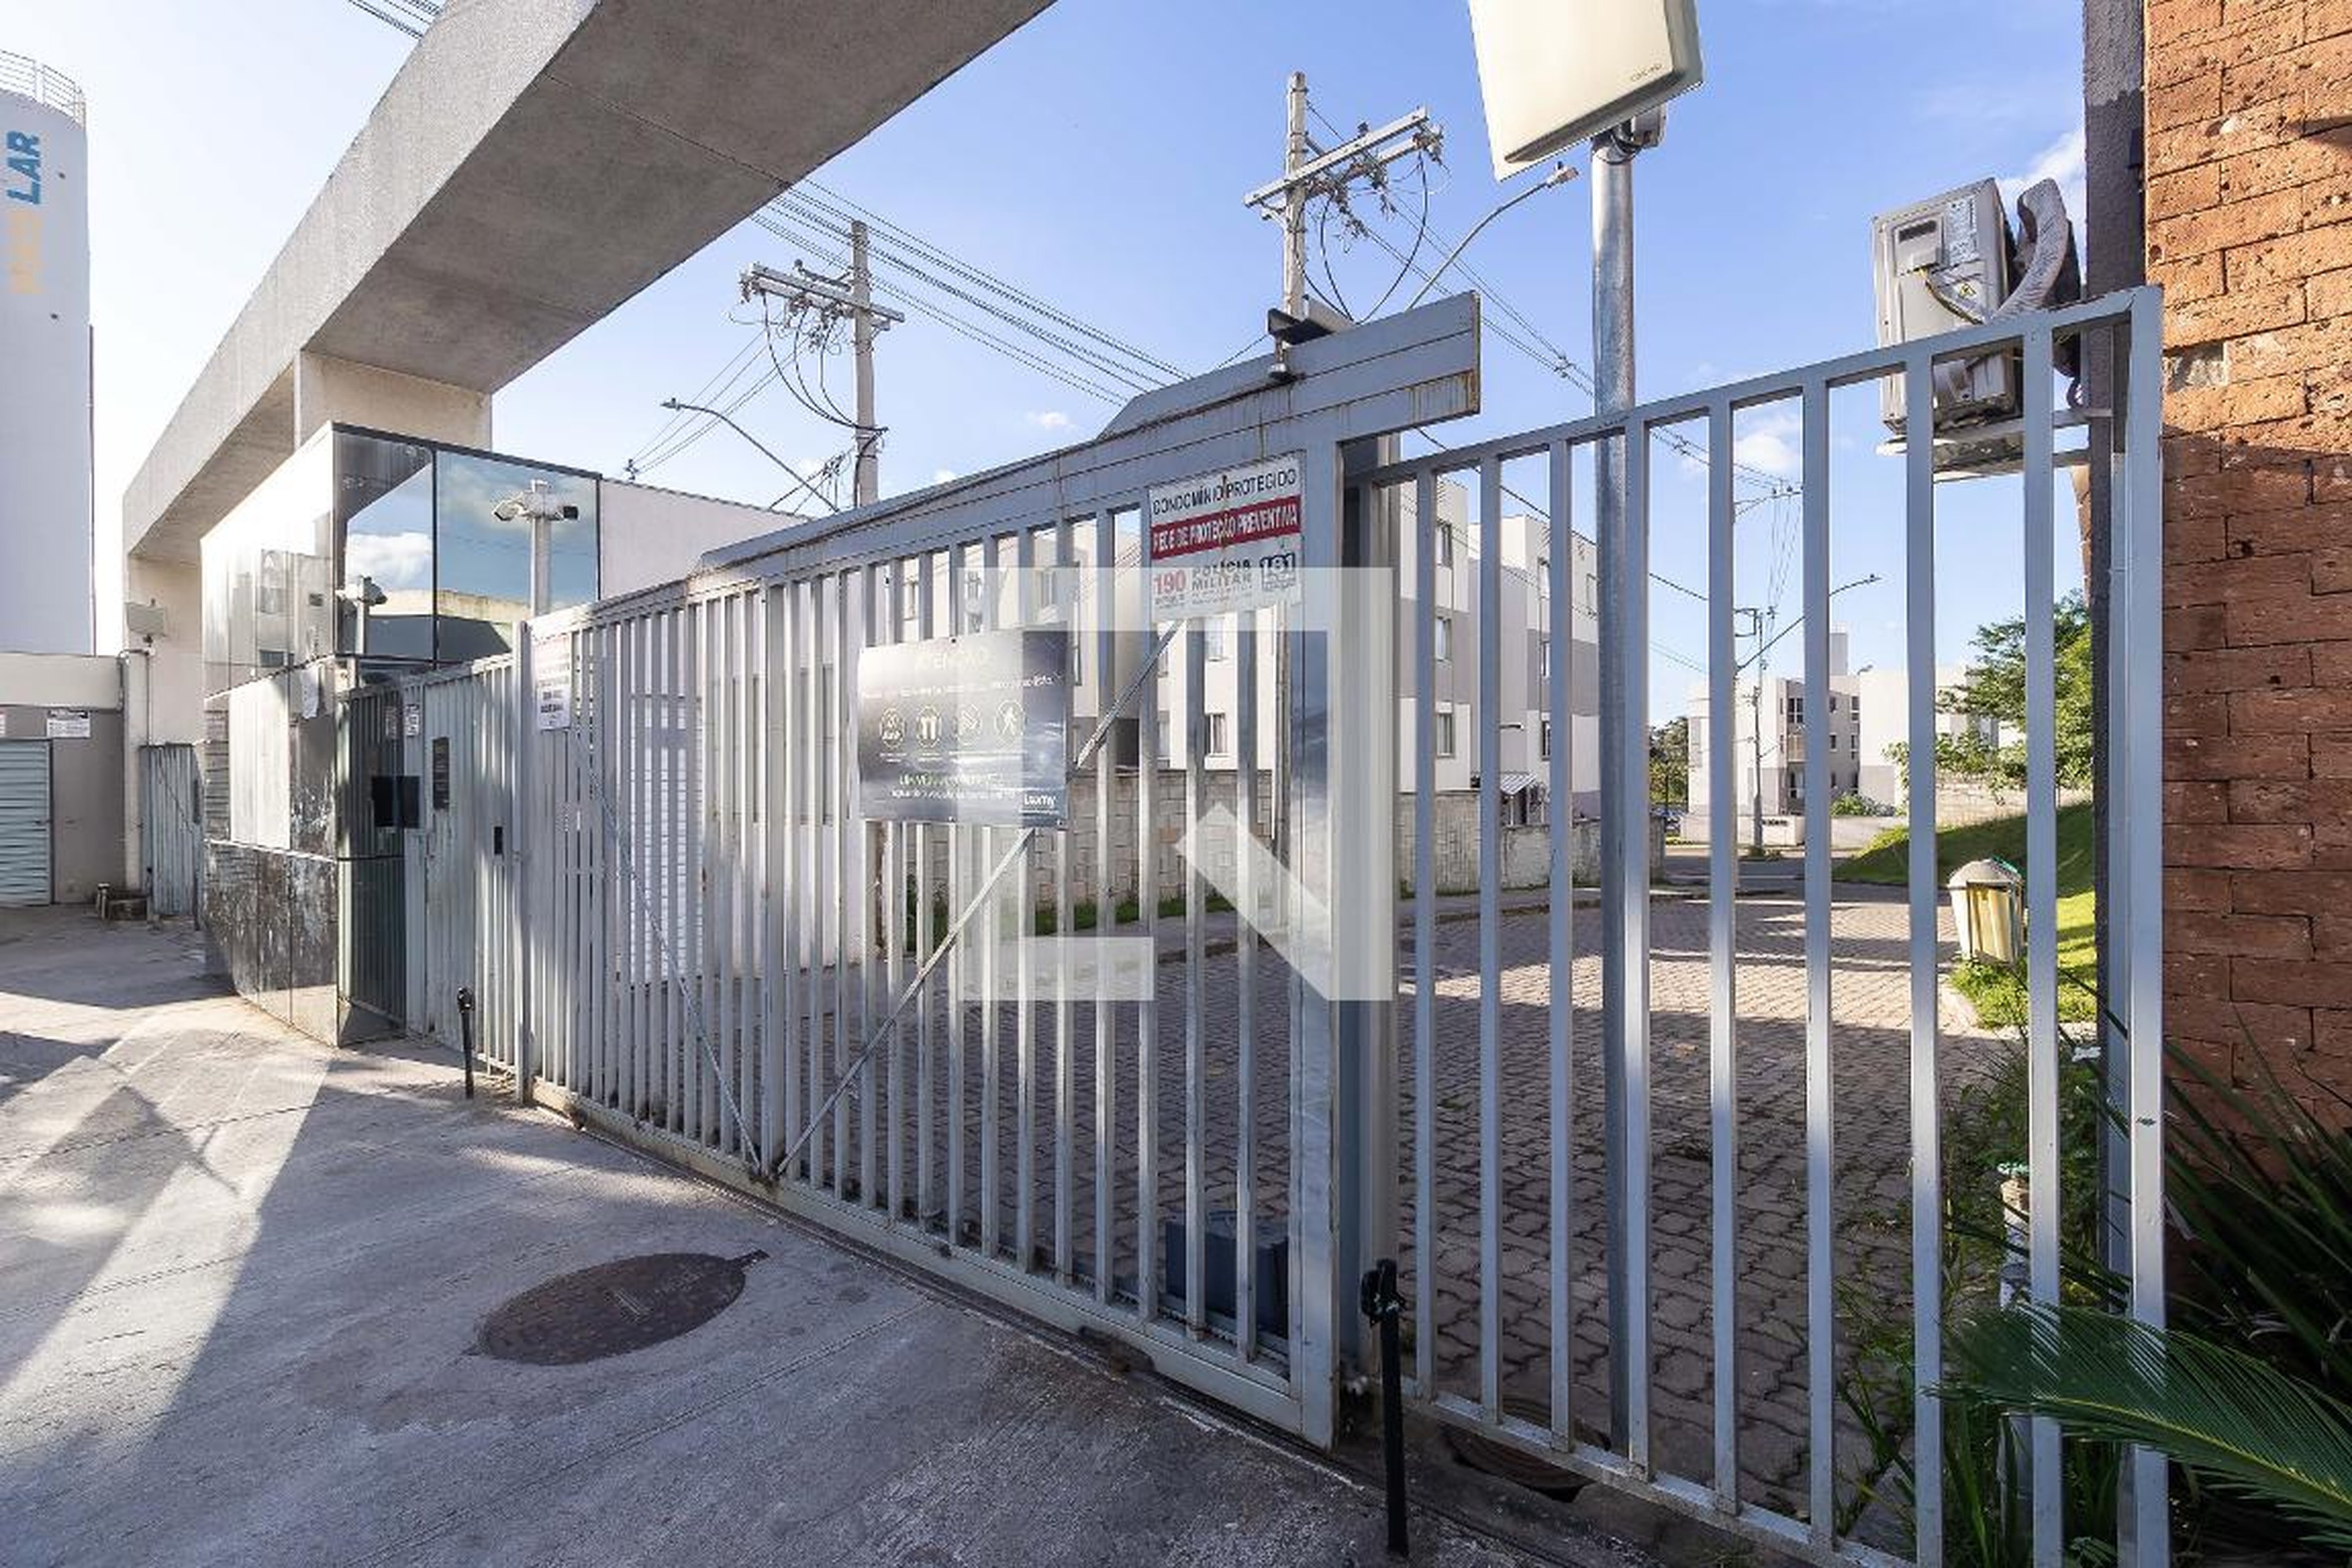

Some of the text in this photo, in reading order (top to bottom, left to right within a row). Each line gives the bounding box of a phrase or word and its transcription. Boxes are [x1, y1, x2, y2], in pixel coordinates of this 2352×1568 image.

[7, 130, 41, 204] LAR
[1153, 469, 1297, 515] CONDOMÍNIO PROTEGIDO
[1237, 503, 1297, 537] PREVENTIVA
[1153, 570, 1186, 595] 190
[1192, 558, 1251, 578] POLÍCIA
[1192, 571, 1253, 591] MILITAR
